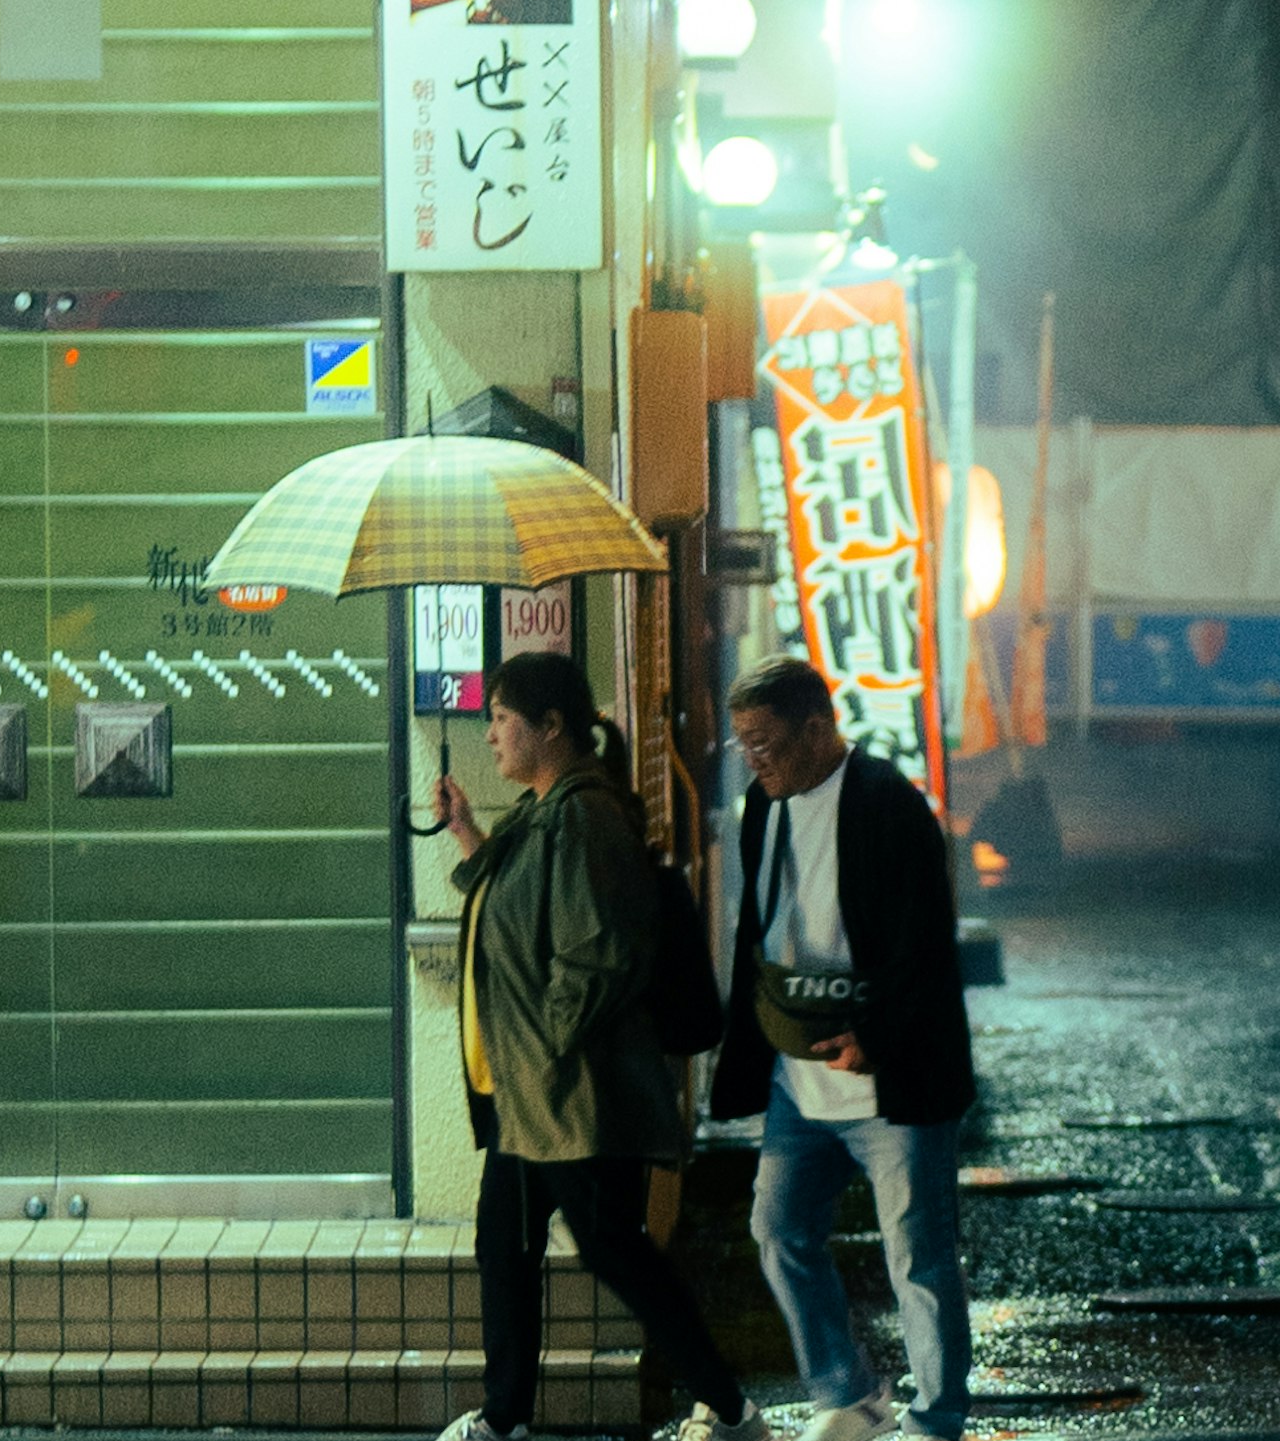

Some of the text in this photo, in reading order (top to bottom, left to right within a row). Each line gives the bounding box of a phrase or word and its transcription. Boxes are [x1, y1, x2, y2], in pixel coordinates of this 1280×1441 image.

[455, 39, 534, 251] せいじ
[505, 597, 566, 641] 1,900
